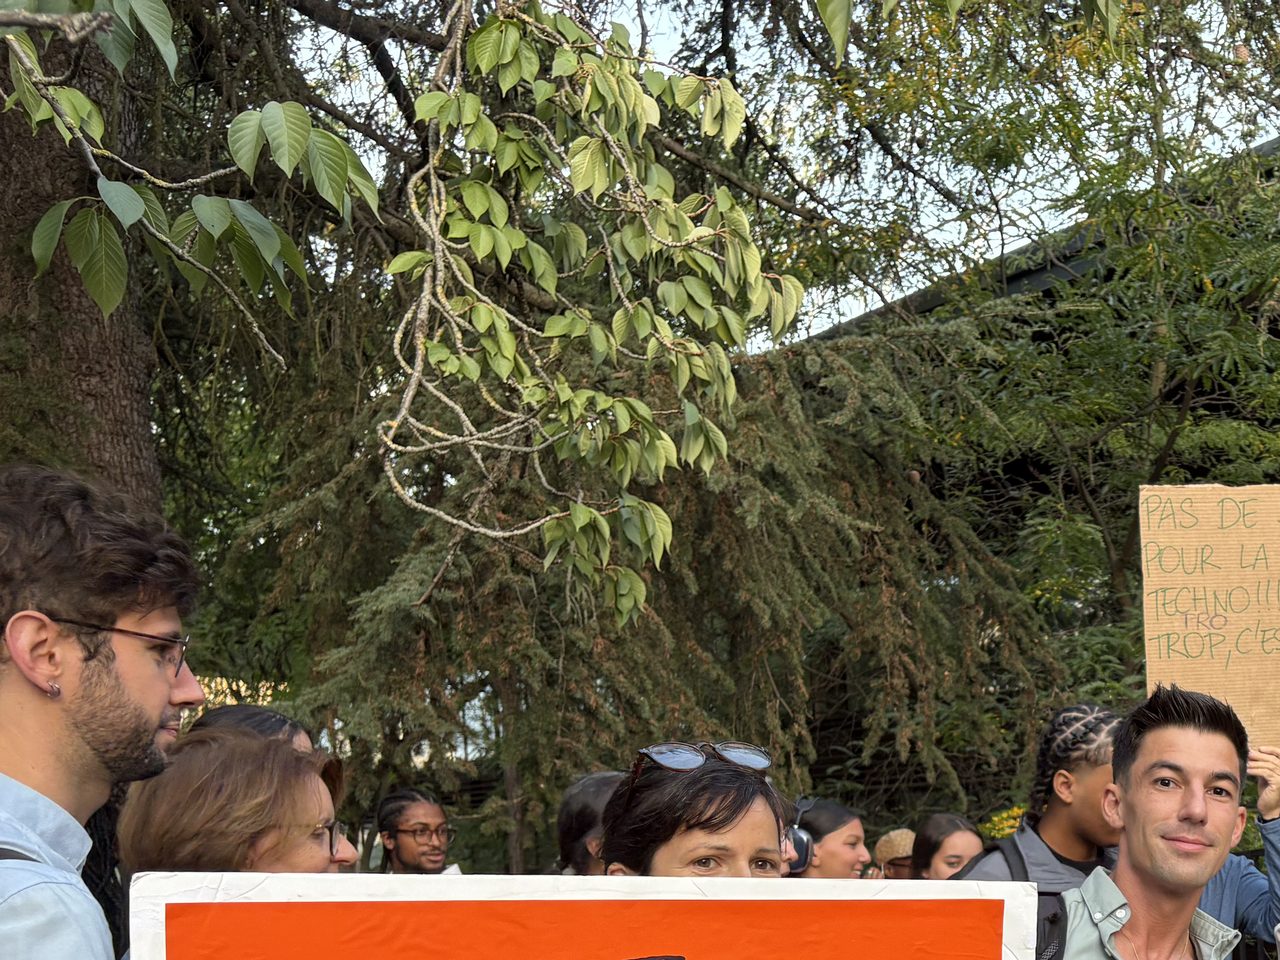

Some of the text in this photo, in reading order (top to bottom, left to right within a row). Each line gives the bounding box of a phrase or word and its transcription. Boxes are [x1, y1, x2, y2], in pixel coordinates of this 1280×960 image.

[1141, 494, 1198, 531] PAS
[1217, 497, 1258, 530] DE
[1142, 541, 1221, 578] POUR
[1240, 543, 1270, 571] LA
[1147, 578, 1280, 621] TECHNO!!!
